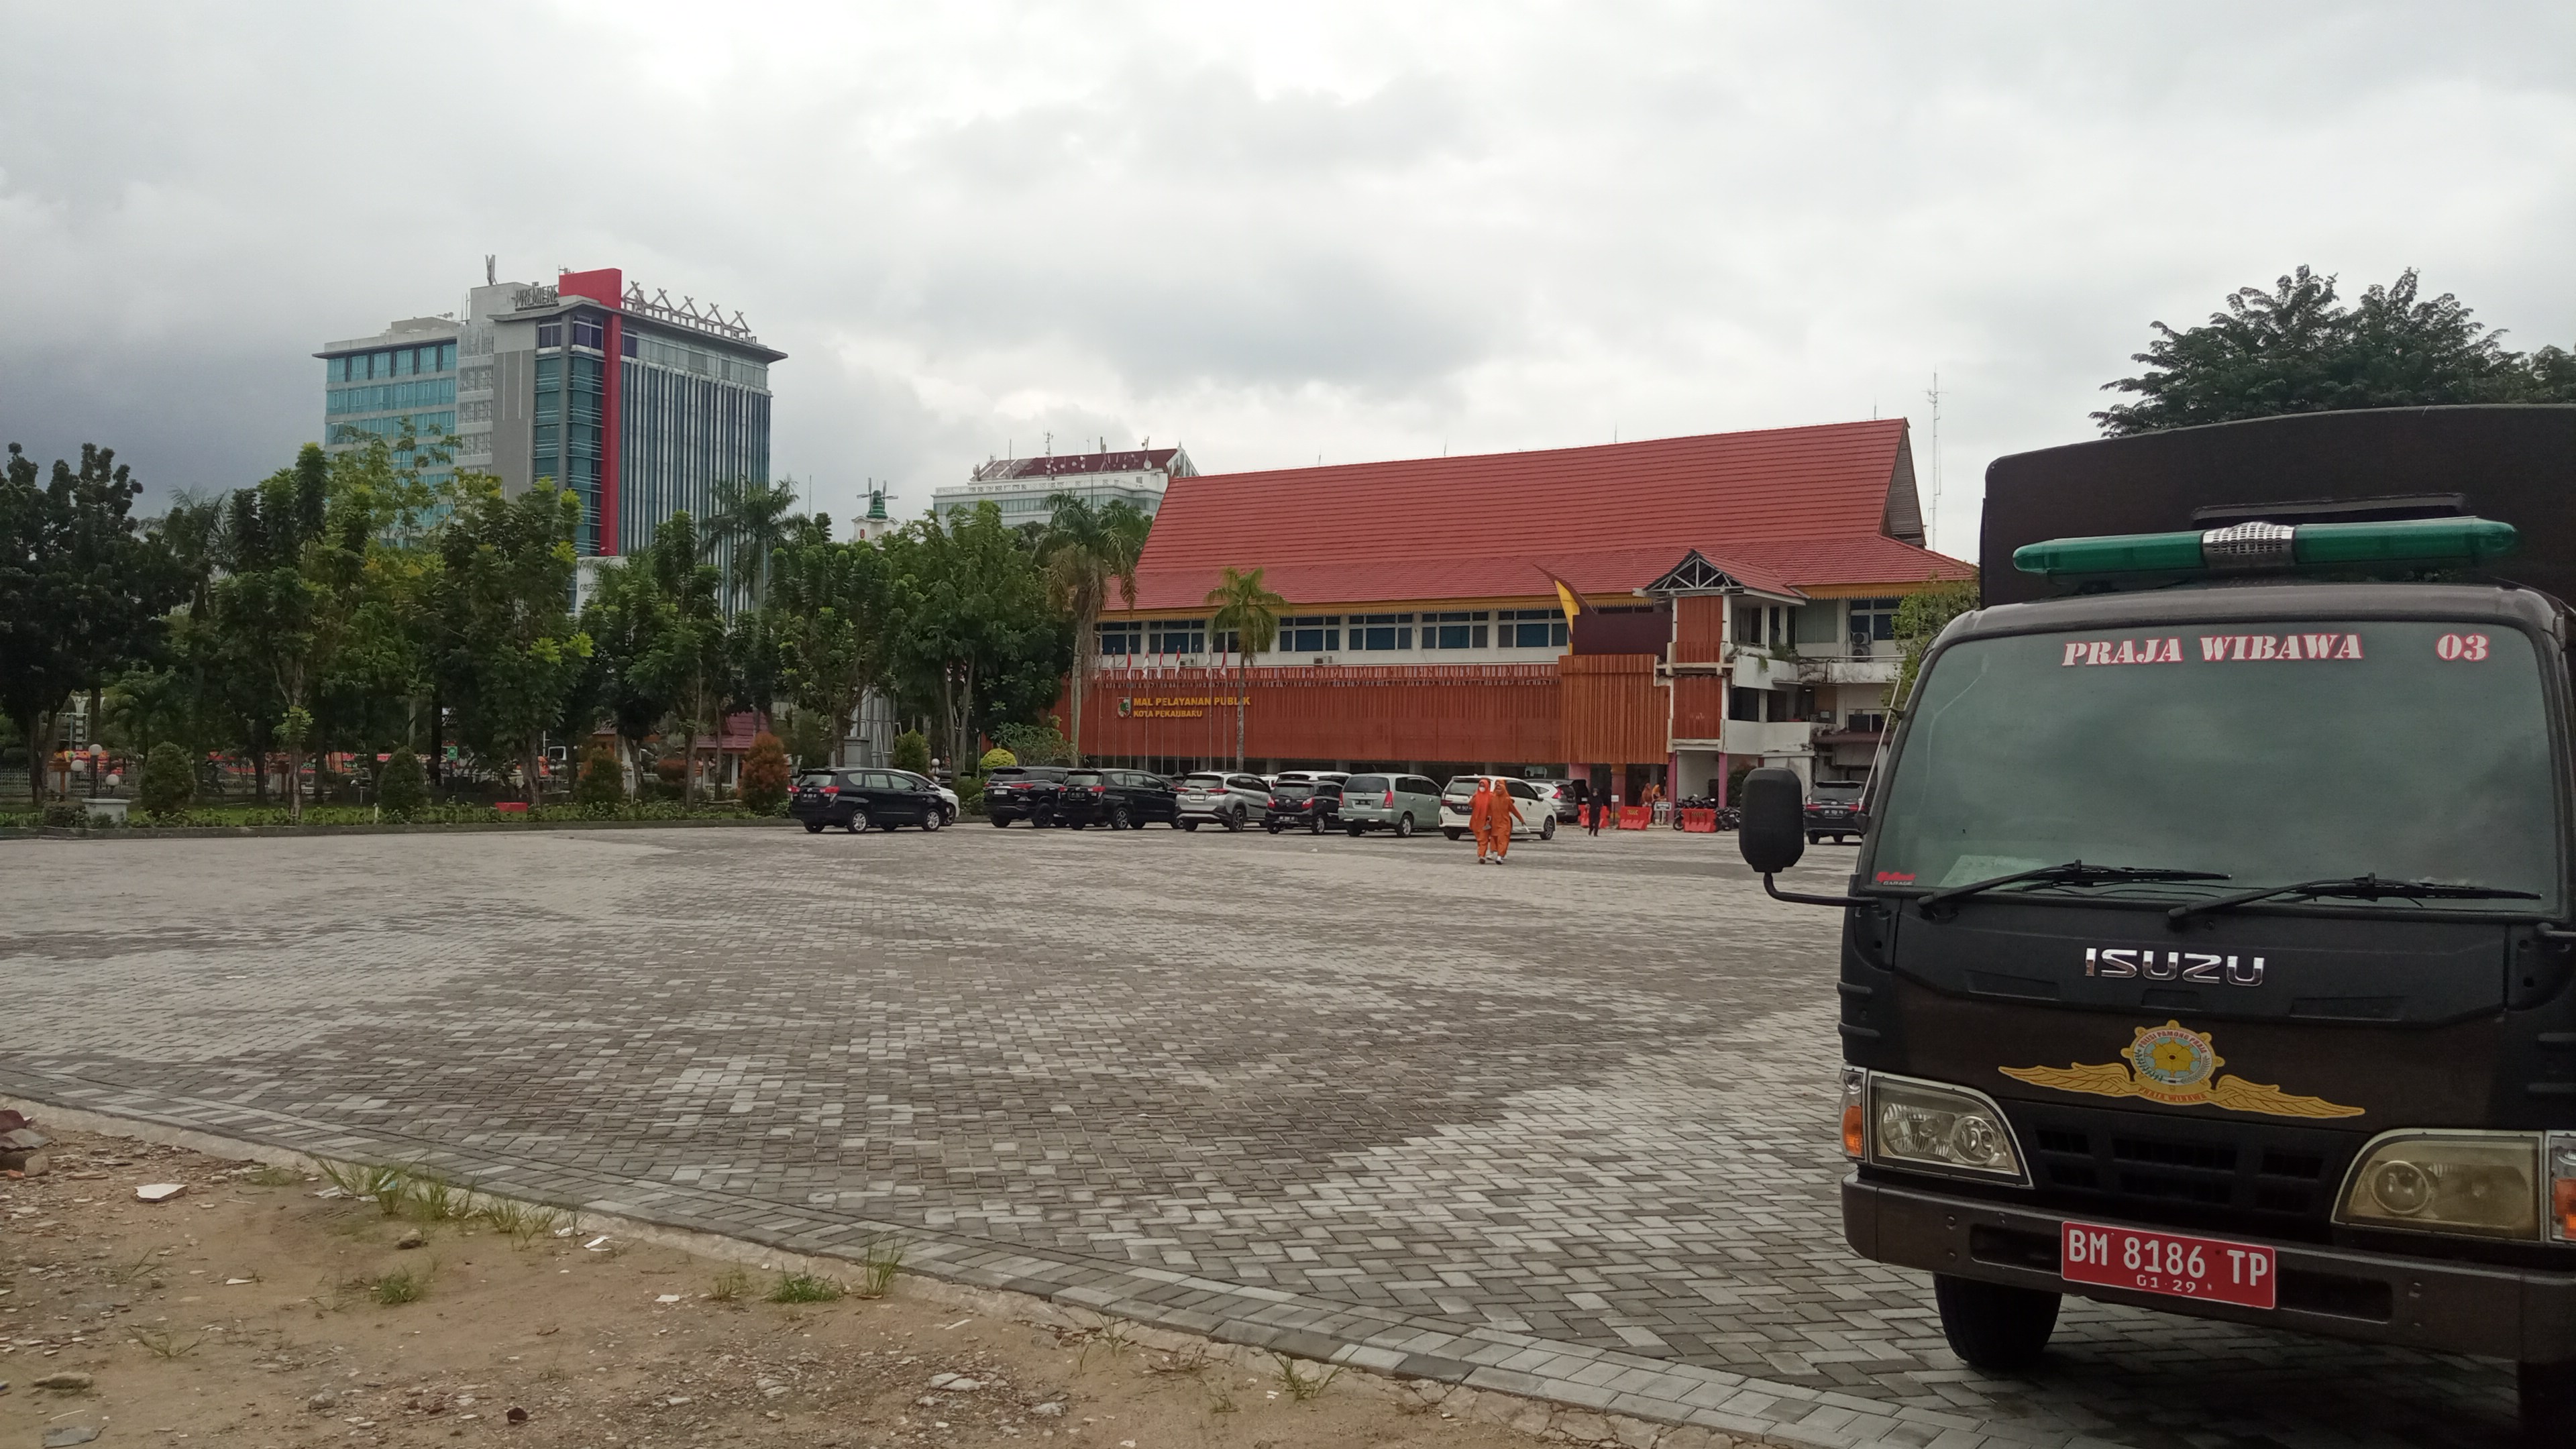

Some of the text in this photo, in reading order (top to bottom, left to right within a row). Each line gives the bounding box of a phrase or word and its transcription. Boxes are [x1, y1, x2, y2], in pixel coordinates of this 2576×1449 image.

[515, 284, 559, 307] PREMIERE
[2061, 634, 2488, 666] PRAJA WIBAWA 03
[1134, 697, 1250, 706] MAL PELAYANAN PUBLK
[2086, 948, 2264, 986] ISUZU
[2069, 1229, 2267, 1286] BM 8186 TP
